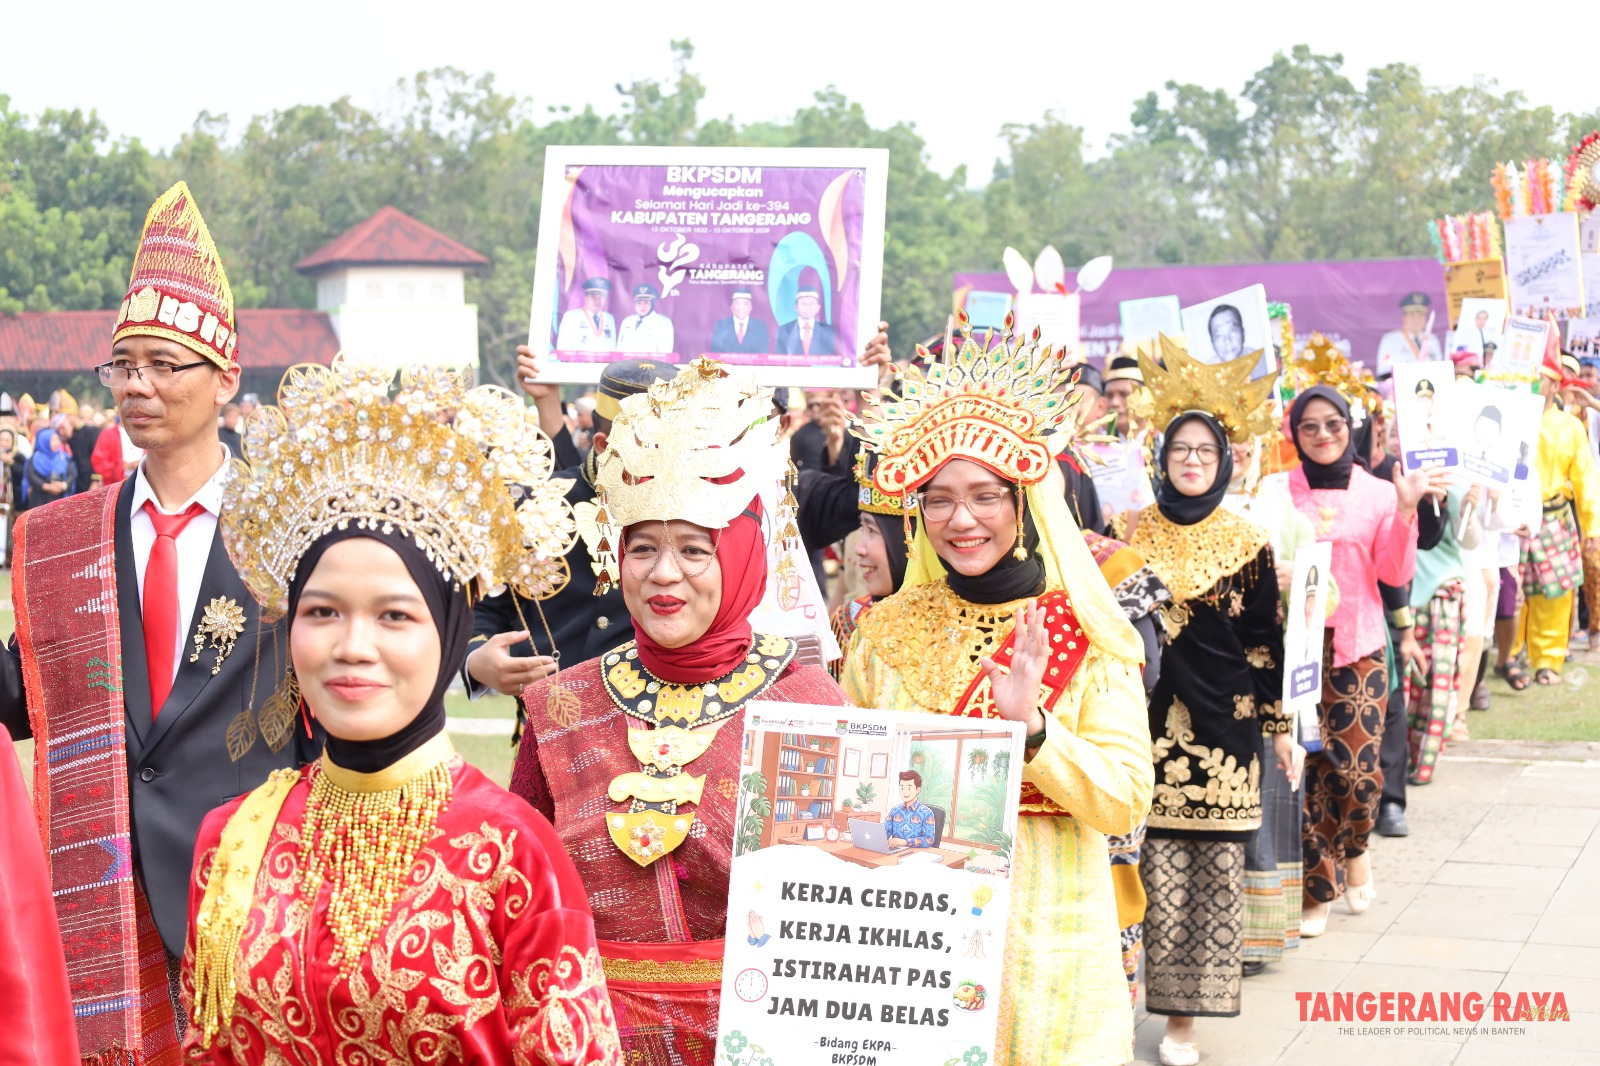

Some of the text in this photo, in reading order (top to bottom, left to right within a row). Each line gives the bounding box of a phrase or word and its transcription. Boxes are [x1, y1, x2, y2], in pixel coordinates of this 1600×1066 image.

[666, 166, 762, 184] BKPSDM
[663, 185, 763, 200] Mengucapkan
[635, 198, 790, 212] Selamat Hari Jadi ke-394
[611, 211, 812, 226] KABUPATEN TANGERANG
[689, 269, 764, 281] TANGERANG
[850, 722, 887, 732] BKPSDM
[781, 881, 957, 916] KERJA CERDAS,
[779, 920, 952, 954] KERJA IKHLAS,
[772, 958, 952, 989] ISTIRAHAT PAS
[767, 996, 950, 1027] JAM DUA BELAS
[831, 1053, 877, 1066] BKPSDM
